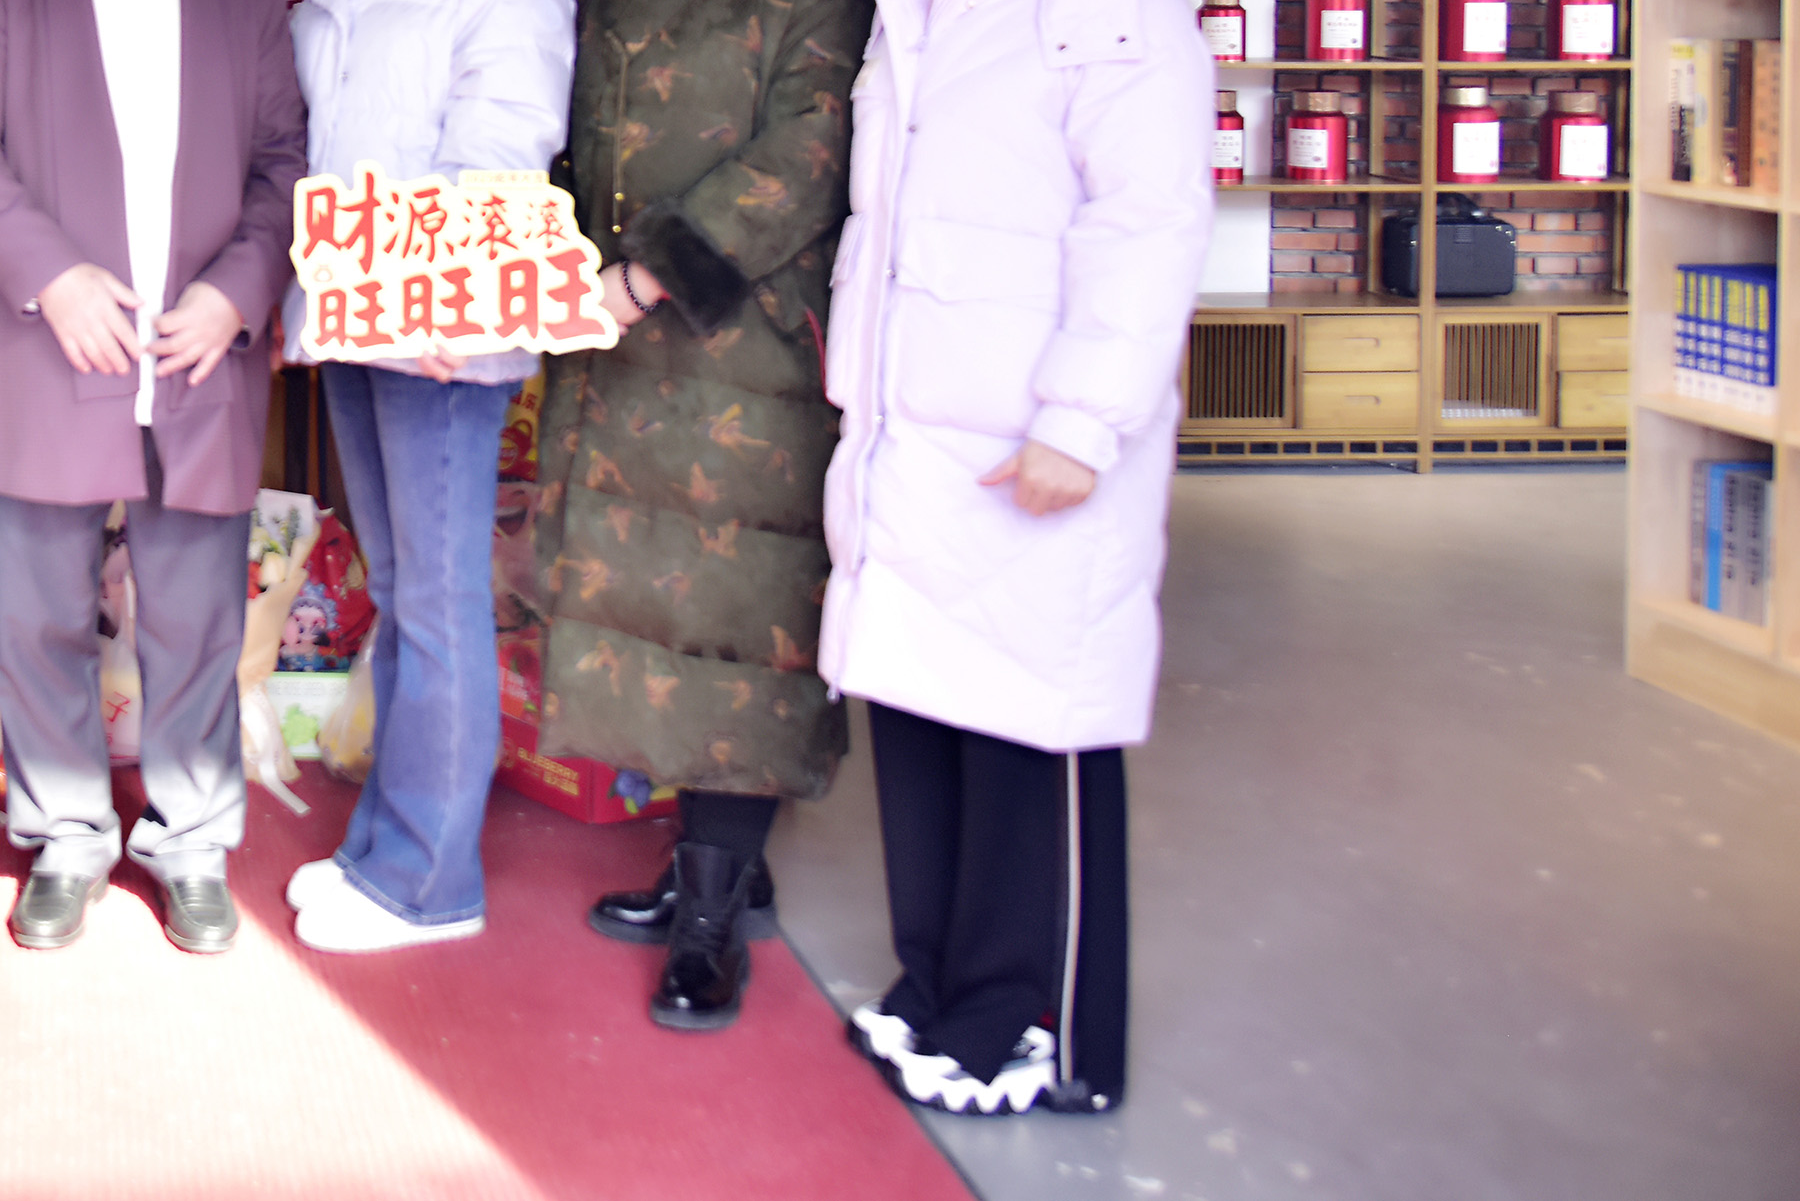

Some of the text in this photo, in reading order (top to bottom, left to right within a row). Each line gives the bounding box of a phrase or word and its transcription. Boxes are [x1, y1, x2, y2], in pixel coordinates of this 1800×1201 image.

[303, 171, 570, 274] 财源滚滚
[314, 248, 606, 348] 旺旺旺
